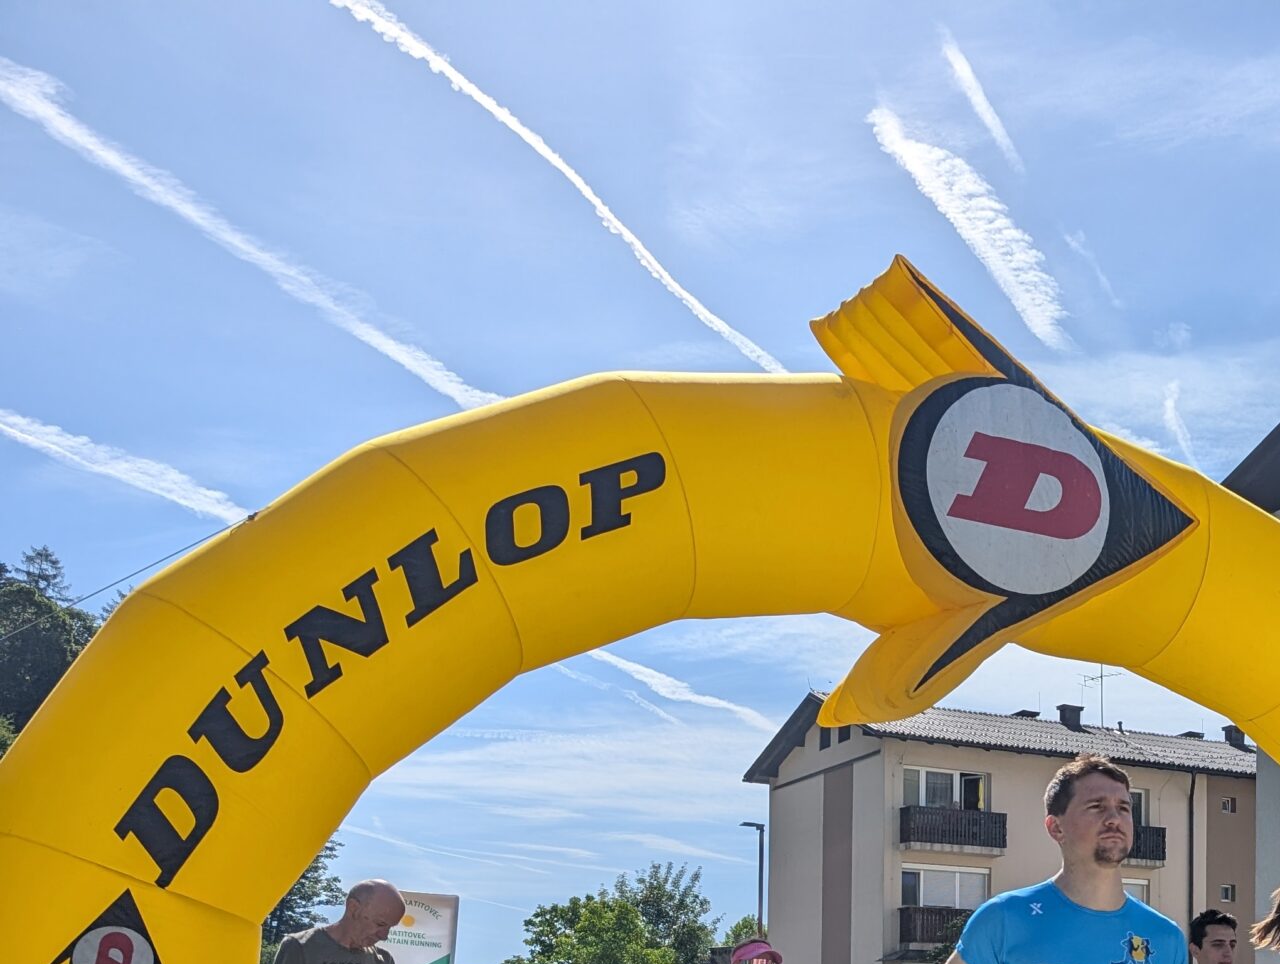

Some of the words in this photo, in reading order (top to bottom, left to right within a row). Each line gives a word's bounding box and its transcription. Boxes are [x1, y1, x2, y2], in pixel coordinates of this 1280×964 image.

[946, 431, 1102, 540] D
[114, 451, 667, 888] DUNLOP
[387, 938, 409, 946] NTAIN
[410, 940, 442, 949] RUNNING
